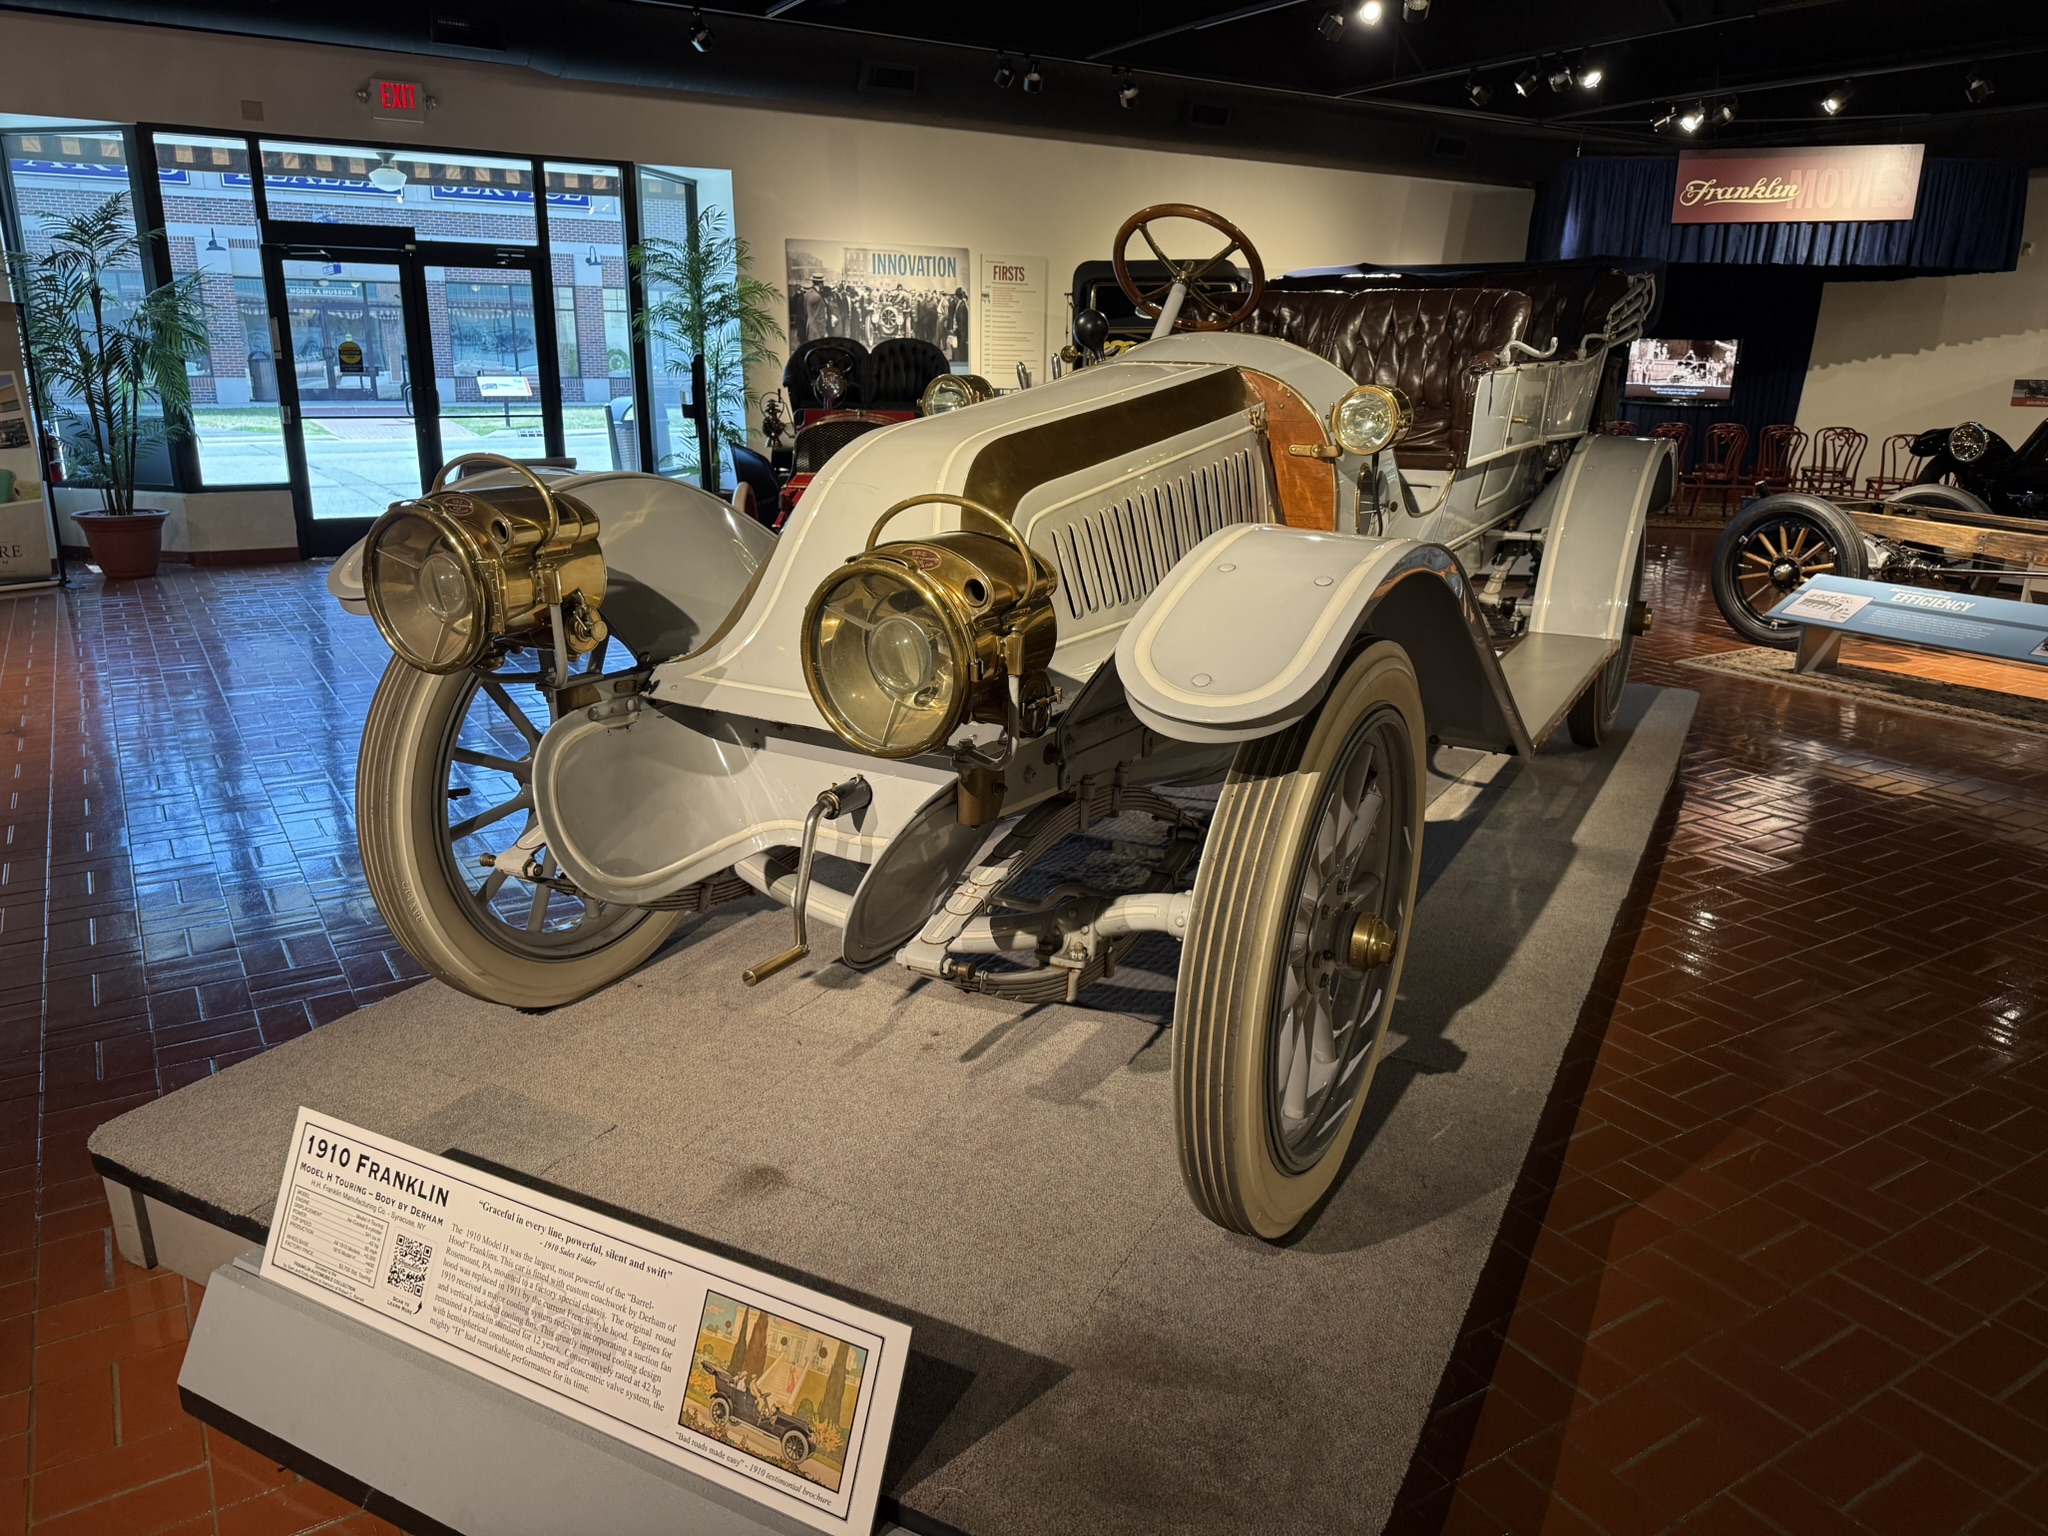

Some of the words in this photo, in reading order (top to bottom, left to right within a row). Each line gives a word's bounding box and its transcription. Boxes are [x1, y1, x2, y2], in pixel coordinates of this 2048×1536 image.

[380, 82, 416, 110] EXIT
[1680, 177, 1800, 206] Franklin
[1786, 167, 1912, 209] MOVIES
[872, 253, 956, 278] INNOVATION
[993, 265, 1025, 282] FIRSTS
[1890, 592, 1976, 612] EFFICIENCY
[299, 1162, 325, 1178] MODEL
[326, 1172, 332, 1182] H
[306, 1134, 352, 1168] 1910
[355, 1153, 450, 1207] FRANKLIN
[310, 1179, 322, 1188] H.H.
[322, 1183, 342, 1196] Franklin
[342, 1191, 377, 1212] Manufacturing
[377, 1206, 385, 1214] Co.
[390, 1211, 416, 1228] Syracuse,
[416, 1222, 425, 1231] NY
[450, 1223, 463, 1235] The
[466, 1229, 481, 1242] 1910
[481, 1235, 502, 1250] Model
[502, 1243, 508, 1253] H
[509, 1248, 522, 1258] was
[522, 1251, 533, 1262] the
[533, 1256, 557, 1274] largest,
[558, 1266, 574, 1278] most
[574, 1272, 605, 1293] powerful
[605, 1284, 614, 1294] of
[614, 1287, 626, 1299] the
[515, 1214, 523, 1224] in
[524, 1220, 545, 1235] every
[547, 1226, 565, 1241] line,
[565, 1233, 604, 1257] powerful,
[605, 1247, 627, 1264] silent
[628, 1256, 645, 1270] and
[543, 1240, 558, 1252] 1910
[558, 1246, 575, 1258] Sales
[576, 1252, 597, 1267] Folder
[440, 1269, 455, 1282] 1910
[455, 1275, 481, 1293] received
[486, 1291, 505, 1305] major
[505, 1296, 530, 1315] cooling
[530, 1307, 553, 1325] system
[553, 1316, 582, 1337] redesign
[581, 1329, 627, 1356] incorporating
[633, 1350, 659, 1367] suction
[660, 1360, 672, 1372] fan
[442, 1258, 458, 1270] hood
[459, 1266, 471, 1276] was
[471, 1270, 497, 1289] replaced
[498, 1281, 505, 1290] in
[505, 1283, 521, 1296] 1911
[521, 1290, 530, 1302] by
[531, 1294, 542, 1305] the
[543, 1299, 565, 1315] current
[609, 1326, 629, 1341] hood.
[632, 1335, 661, 1356] Engines
[661, 1347, 672, 1359] for
[445, 1246, 481, 1268] Rosemount,
[481, 1261, 493, 1273] PA,
[493, 1266, 521, 1283] mounted
[521, 1277, 528, 1287] to
[534, 1282, 557, 1300] factory
[557, 1291, 581, 1310] special
[581, 1301, 607, 1319] chassis.
[610, 1312, 625, 1326] The
[624, 1318, 652, 1339] original
[655, 1330, 676, 1346] round
[468, 1243, 499, 1262] Franklins.
[499, 1255, 514, 1268] This
[514, 1263, 524, 1272] car
[525, 1266, 532, 1275] is
[532, 1268, 549, 1282] fitted
[550, 1275, 565, 1288] with
[565, 1282, 590, 1298] custom
[590, 1291, 627, 1313] coachwork
[627, 1306, 637, 1320] by
[638, 1310, 666, 1329] Derham
[667, 1321, 676, 1333] of
[429, 1316, 450, 1333] mighty
[464, 1331, 476, 1343] had
[476, 1336, 511, 1358] remarkable
[511, 1351, 551, 1378] performance
[552, 1369, 563, 1381] for
[563, 1375, 572, 1385] its
[572, 1379, 590, 1393] time.
[432, 1304, 446, 1316] with
[445, 1310, 487, 1336] hemispherical
[488, 1328, 524, 1350] combustion
[525, 1344, 556, 1364] chambers
[556, 1357, 569, 1370] and
[570, 1364, 604, 1385] concentric
[605, 1379, 625, 1394] valve
[624, 1388, 652, 1408] system,
[652, 1399, 664, 1411] the
[434, 1292, 462, 1311] remained
[467, 1306, 493, 1324] Franklin
[494, 1318, 521, 1336] standard
[521, 1329, 532, 1340] for
[532, 1334, 541, 1344] 12
[541, 1340, 561, 1355] years.
[563, 1347, 614, 1378] Conservatively
[614, 1369, 633, 1384] rated
[633, 1377, 640, 1387] at
[640, 1380, 651, 1391] 42
[651, 1384, 662, 1398] hp
[437, 1281, 449, 1292] and
[449, 1286, 474, 1304] vertical,
[473, 1296, 500, 1316] jacketed
[500, 1307, 524, 1326] cooling
[524, 1317, 538, 1330] fins.
[539, 1323, 554, 1337] This
[554, 1330, 579, 1349] greatly
[578, 1340, 611, 1363] improved
[611, 1354, 638, 1374] cooling
[637, 1365, 662, 1384] design
[691, 1438, 708, 1452] roads
[708, 1446, 725, 1459] made
[749, 1463, 765, 1477] 1910
[765, 1470, 801, 1493] testimonial
[801, 1486, 831, 1506] brochure
